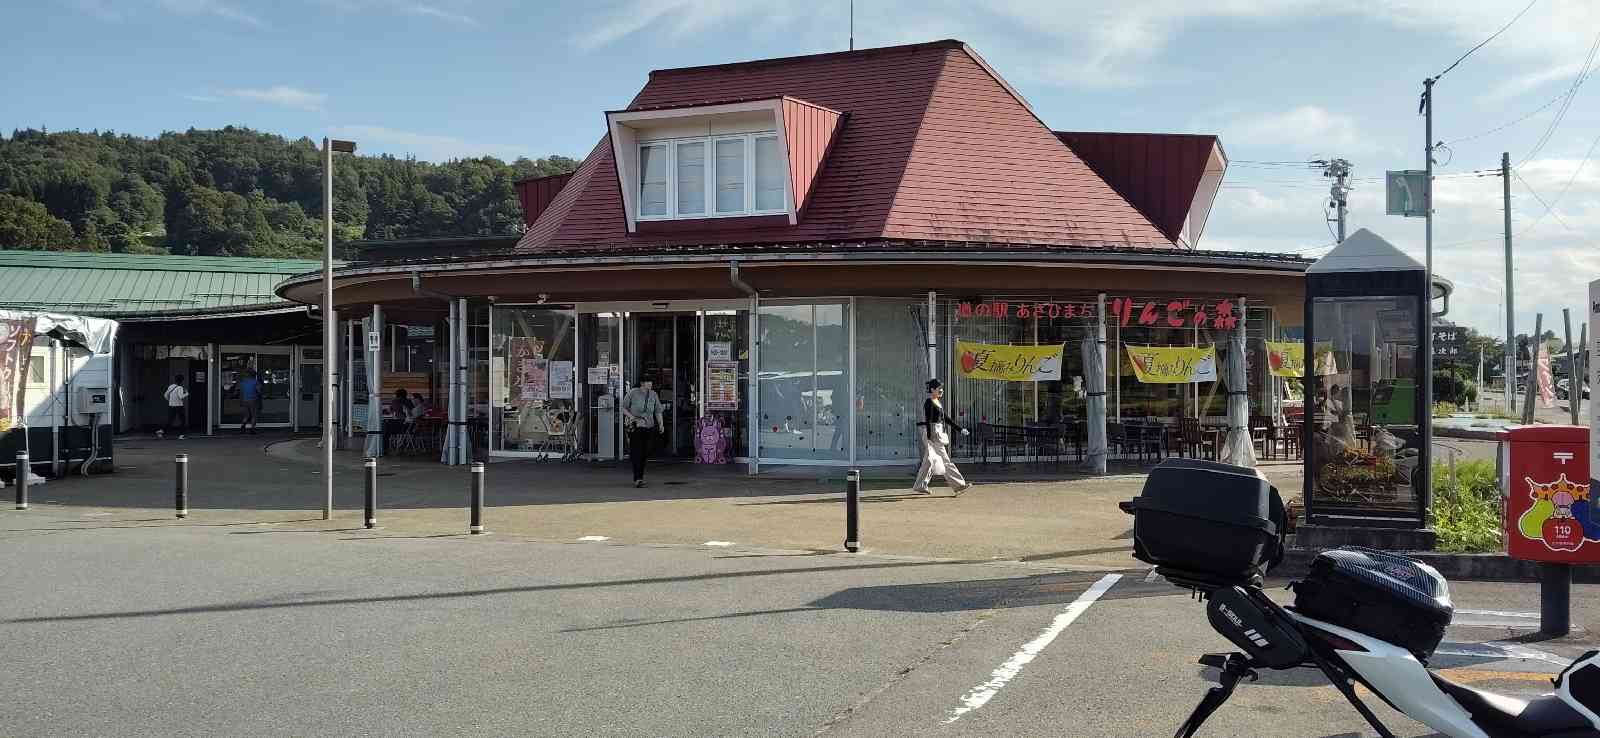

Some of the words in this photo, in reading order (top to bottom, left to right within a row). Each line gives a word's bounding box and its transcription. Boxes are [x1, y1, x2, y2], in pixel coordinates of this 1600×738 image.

[957, 301, 1008, 319] 道の駅
[1017, 303, 1093, 319] あさひまち
